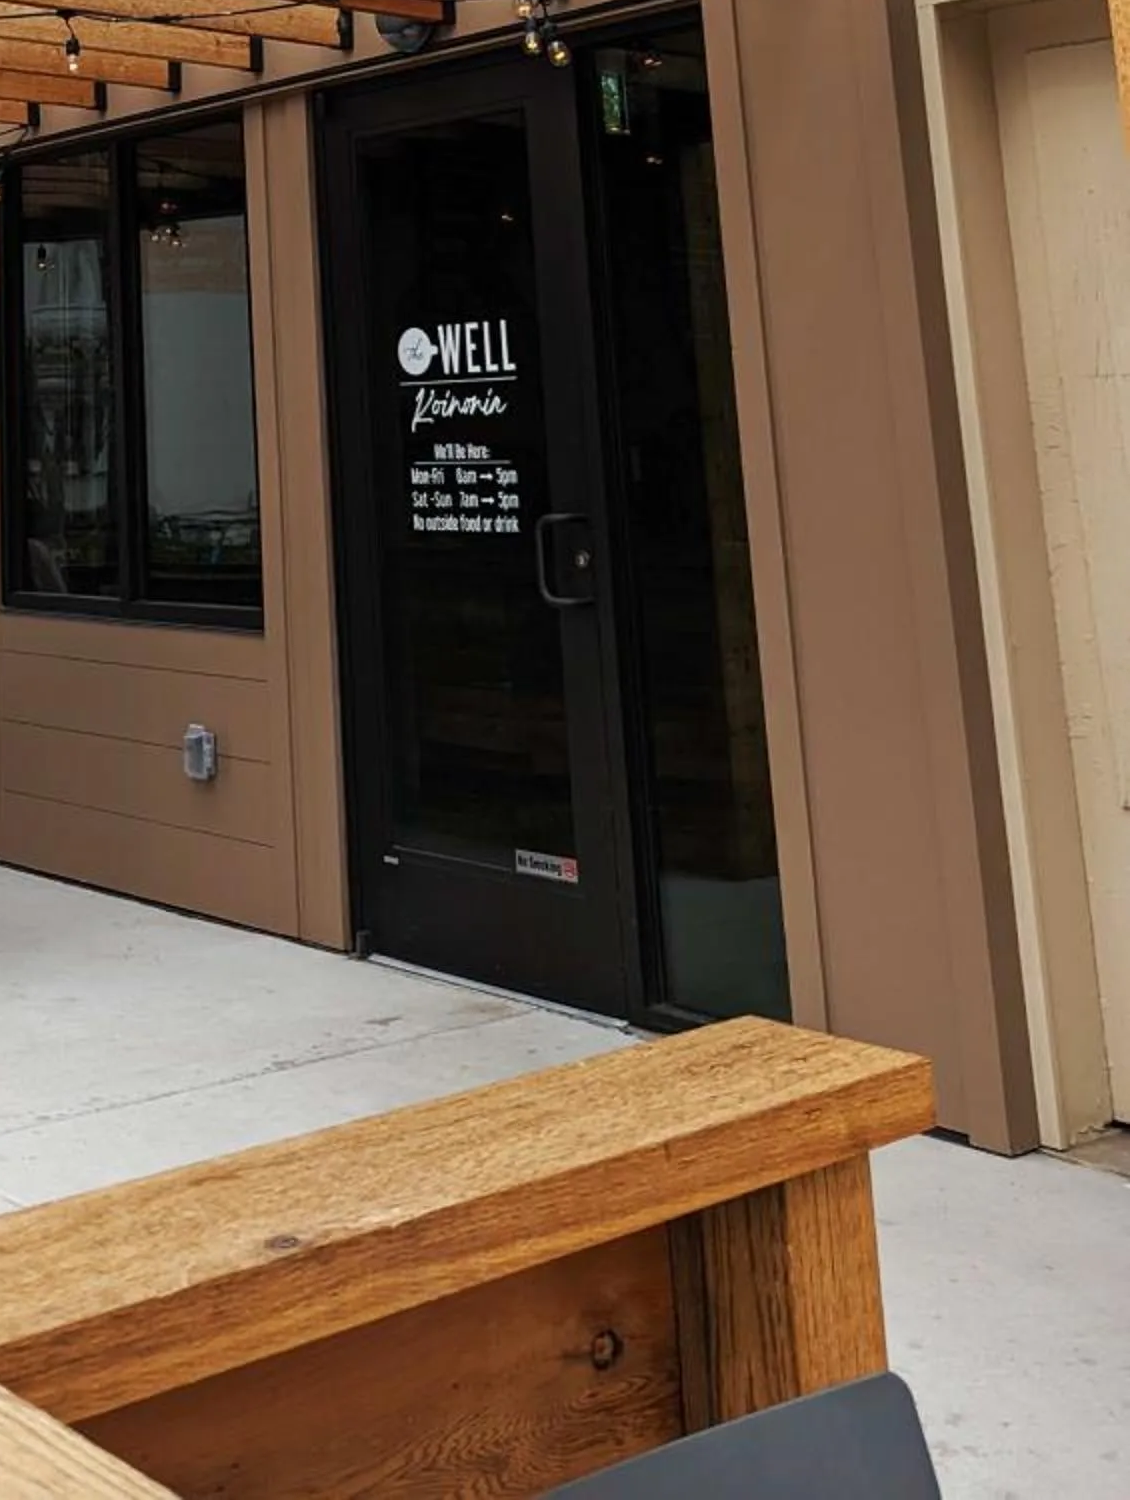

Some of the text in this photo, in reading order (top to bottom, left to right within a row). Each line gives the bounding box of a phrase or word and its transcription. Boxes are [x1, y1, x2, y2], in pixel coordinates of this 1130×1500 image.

[437, 319, 517, 375] WELL
[495, 468, 518, 487] 5pm
[459, 491, 479, 508] 7am
[497, 491, 519, 510] 5pm
[413, 514, 519, 532] No outside food or drink
